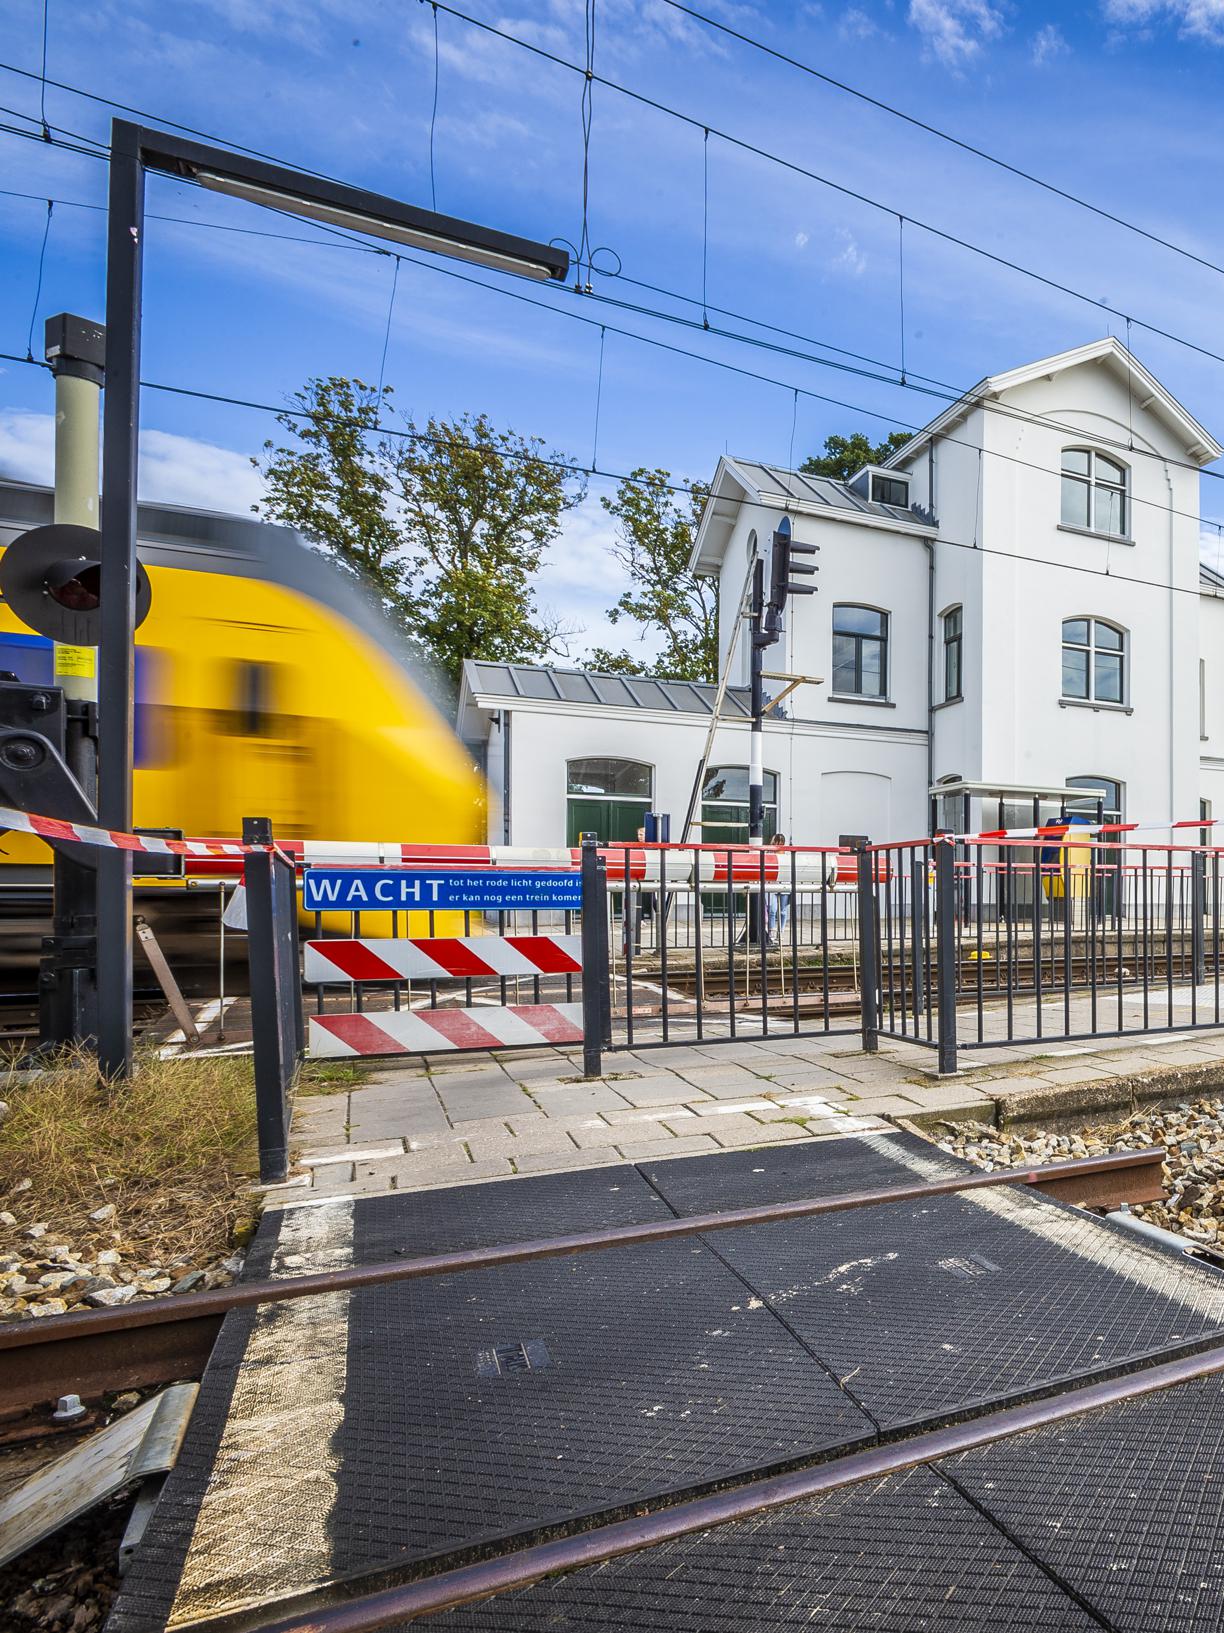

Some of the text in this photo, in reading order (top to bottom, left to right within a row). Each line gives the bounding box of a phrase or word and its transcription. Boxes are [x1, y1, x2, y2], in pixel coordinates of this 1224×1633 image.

[449, 879, 464, 887] tot
[467, 879, 484, 887] het
[486, 879, 509, 887] rode
[511, 878, 533, 887] licht
[535, 879, 574, 889] gedoofd
[308, 878, 445, 901] WACHT
[462, 893, 481, 901] kan
[483, 894, 503, 902] nog
[526, 893, 549, 901] trein
